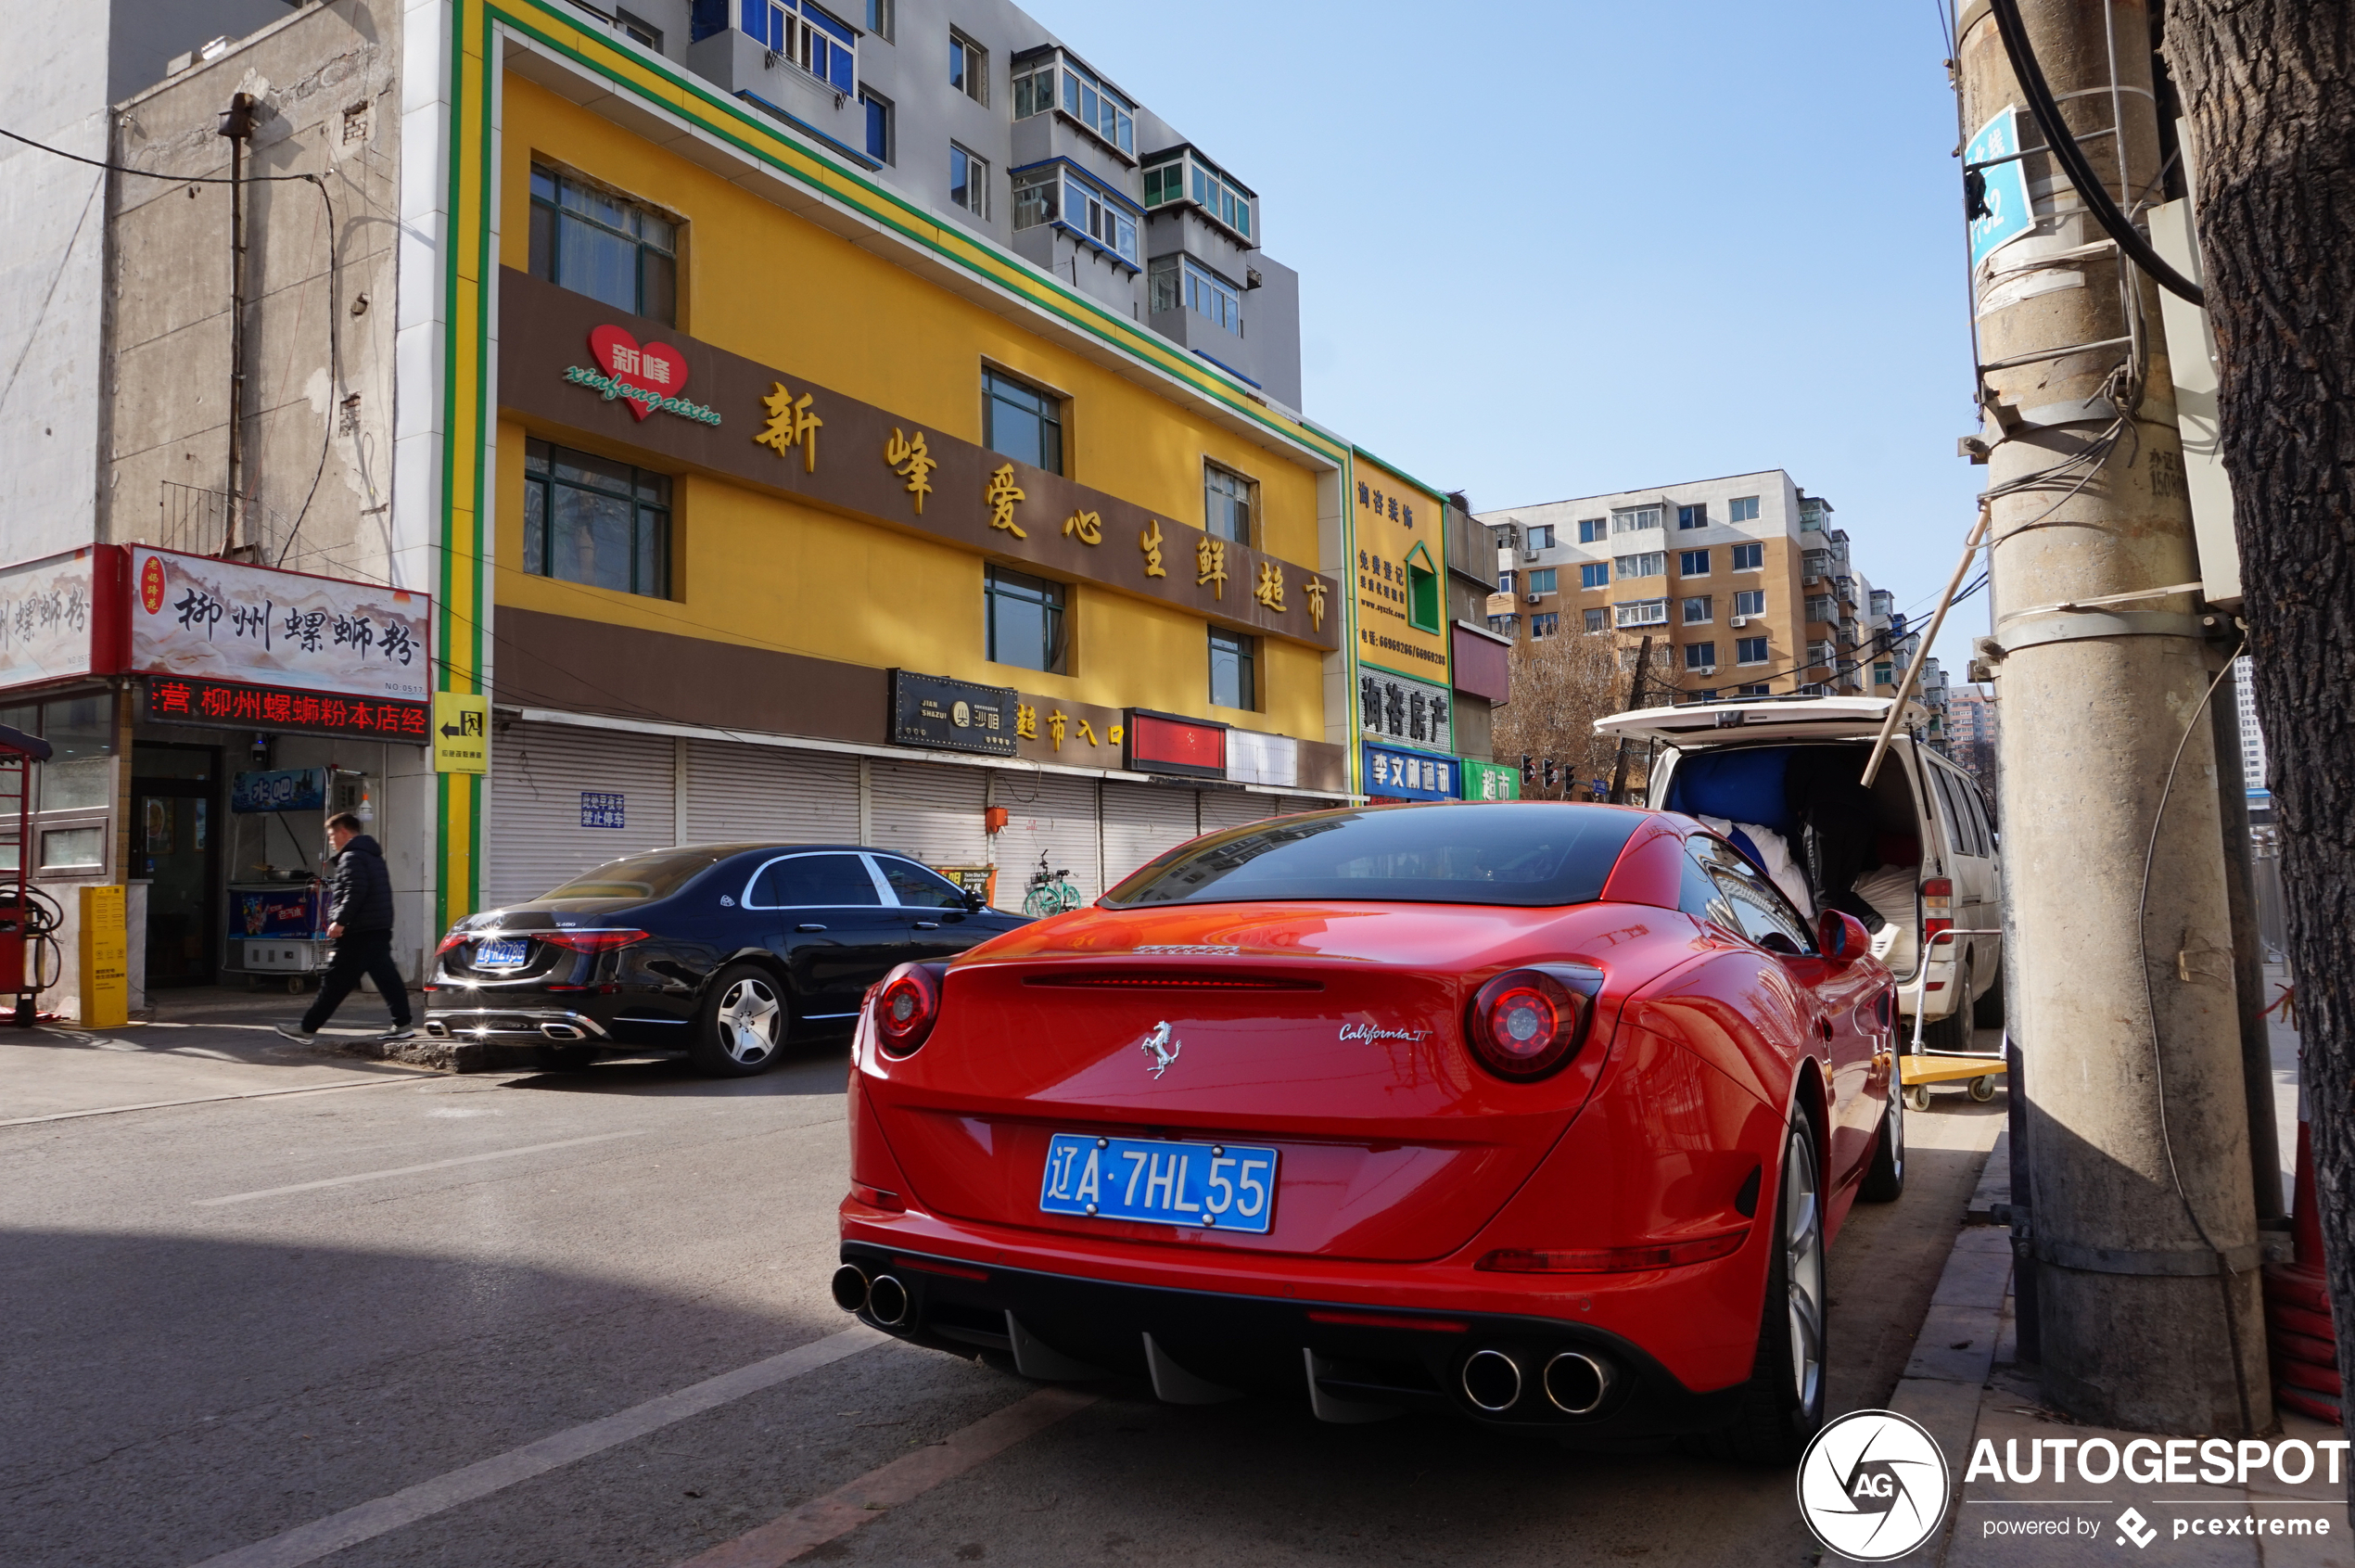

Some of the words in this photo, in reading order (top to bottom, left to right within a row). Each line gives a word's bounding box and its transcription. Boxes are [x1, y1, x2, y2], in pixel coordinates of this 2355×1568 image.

[612, 342, 670, 385] 新峰
[563, 364, 722, 427] xinfengaixin
[752, 381, 1328, 633] 新峰爱心生鲜超市
[1358, 481, 1413, 530] 询咨装饰
[146, 559, 159, 611] 老妈蹄花
[1360, 549, 1404, 586] 免费登记
[173, 587, 420, 667] 柳州螺蛳粉
[201, 686, 426, 733] 柳州螺蛳粉本店经
[384, 682, 424, 695] NO:0517
[922, 709, 947, 719] SHAZUI
[1017, 703, 1125, 752] 超市入口
[1361, 678, 1448, 743] 询咨房产
[252, 776, 291, 802] 水吧
[1372, 753, 1449, 793] 李文刚通讯
[1482, 768, 1510, 801] 超市
[582, 810, 624, 827] 禁止停车
[1339, 1023, 1410, 1045] California
